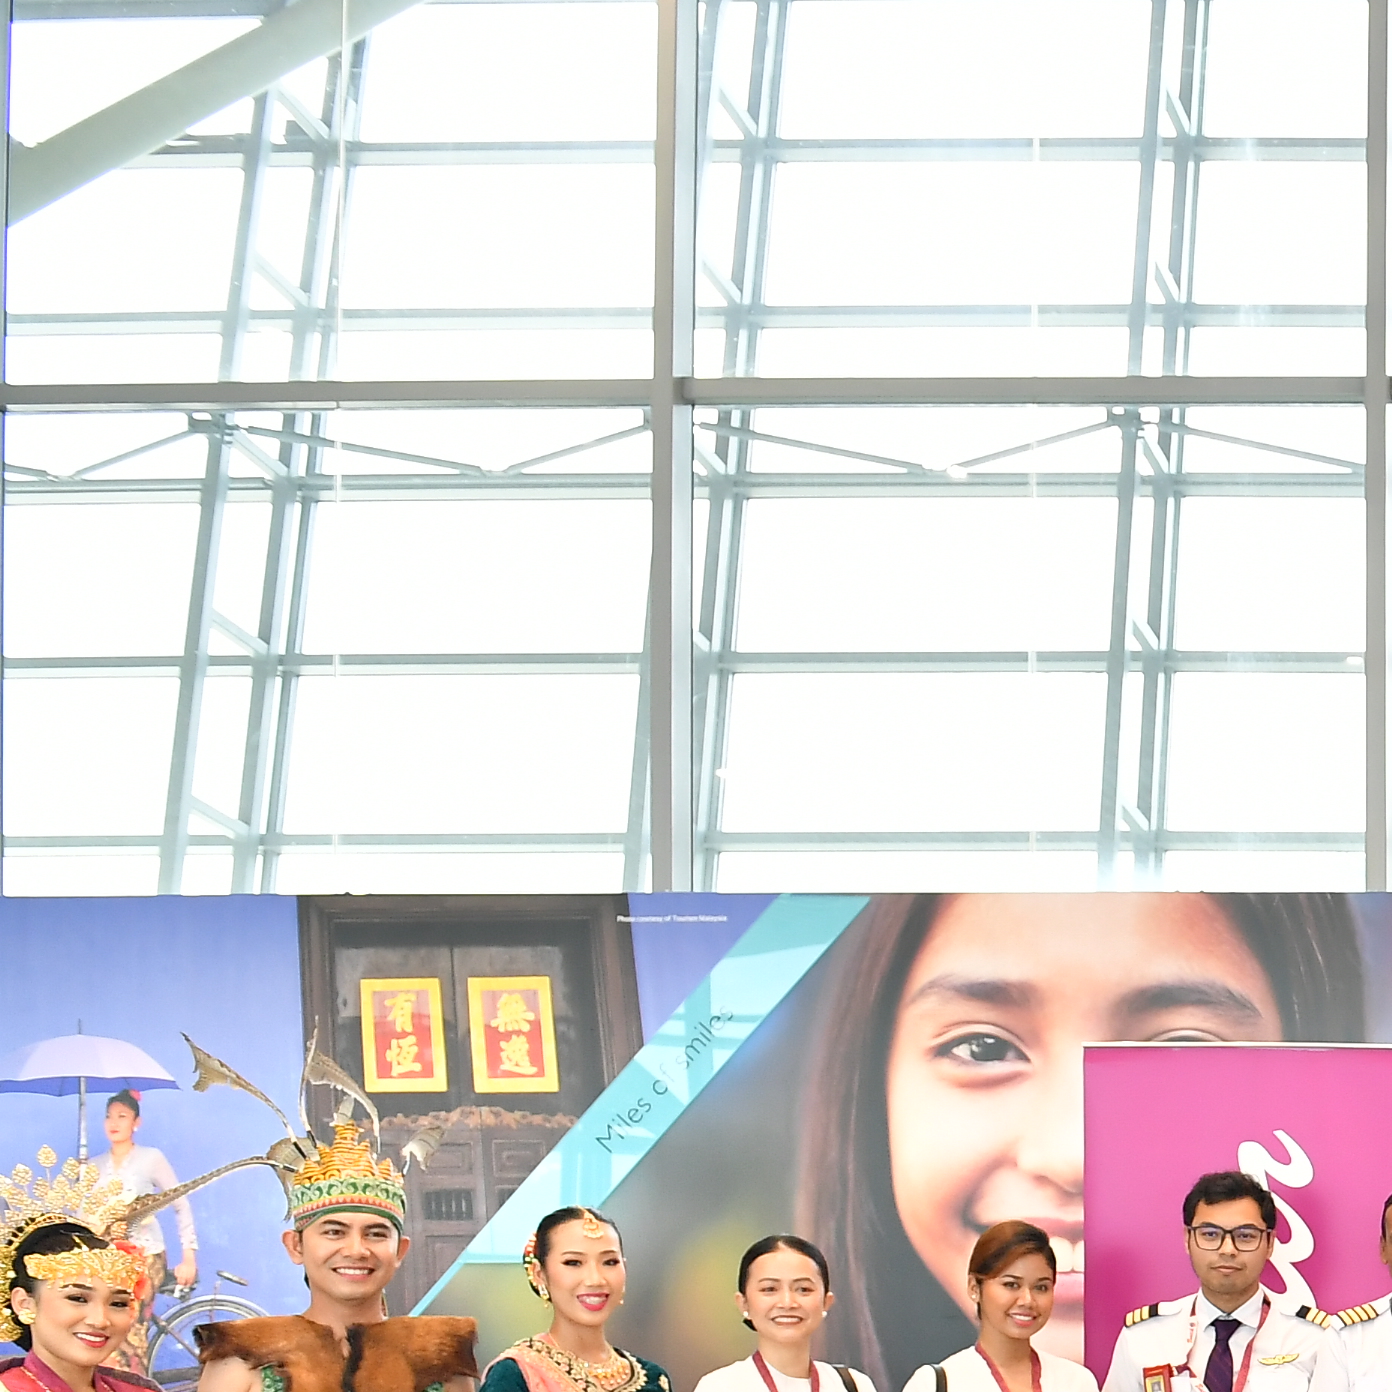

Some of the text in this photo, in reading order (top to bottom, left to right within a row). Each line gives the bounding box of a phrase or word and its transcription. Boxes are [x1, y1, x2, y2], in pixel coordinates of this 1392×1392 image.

[595, 1005, 733, 1154] Miles of smiles
